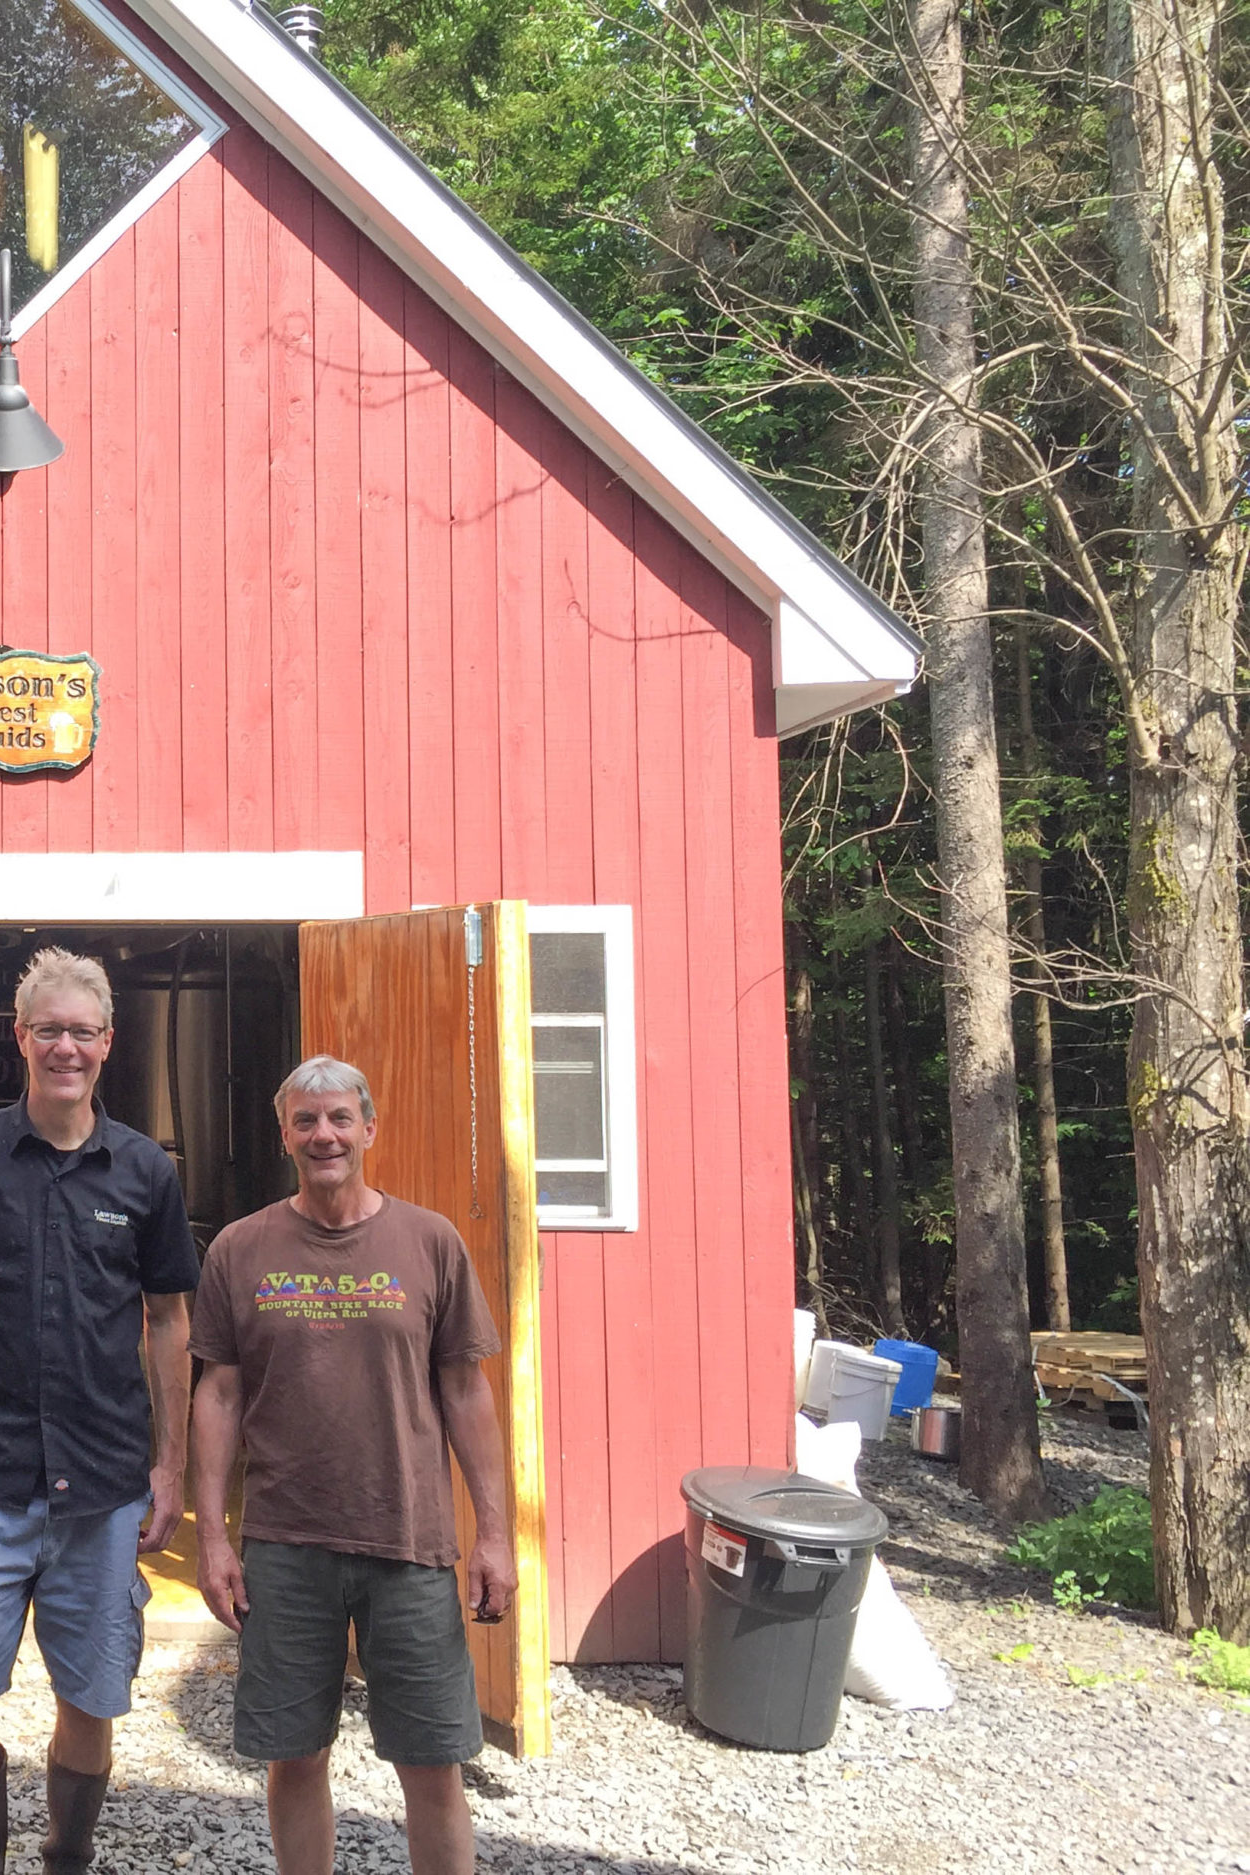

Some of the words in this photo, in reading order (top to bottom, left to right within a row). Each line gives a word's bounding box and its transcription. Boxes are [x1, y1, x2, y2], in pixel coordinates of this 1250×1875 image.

[258, 1300, 324, 1312] MOUNTAIN
[330, 1301, 362, 1309] BIKE
[368, 1300, 403, 1310] RACE
[304, 1309, 337, 1319] Ultra
[342, 1309, 368, 1318] Run
